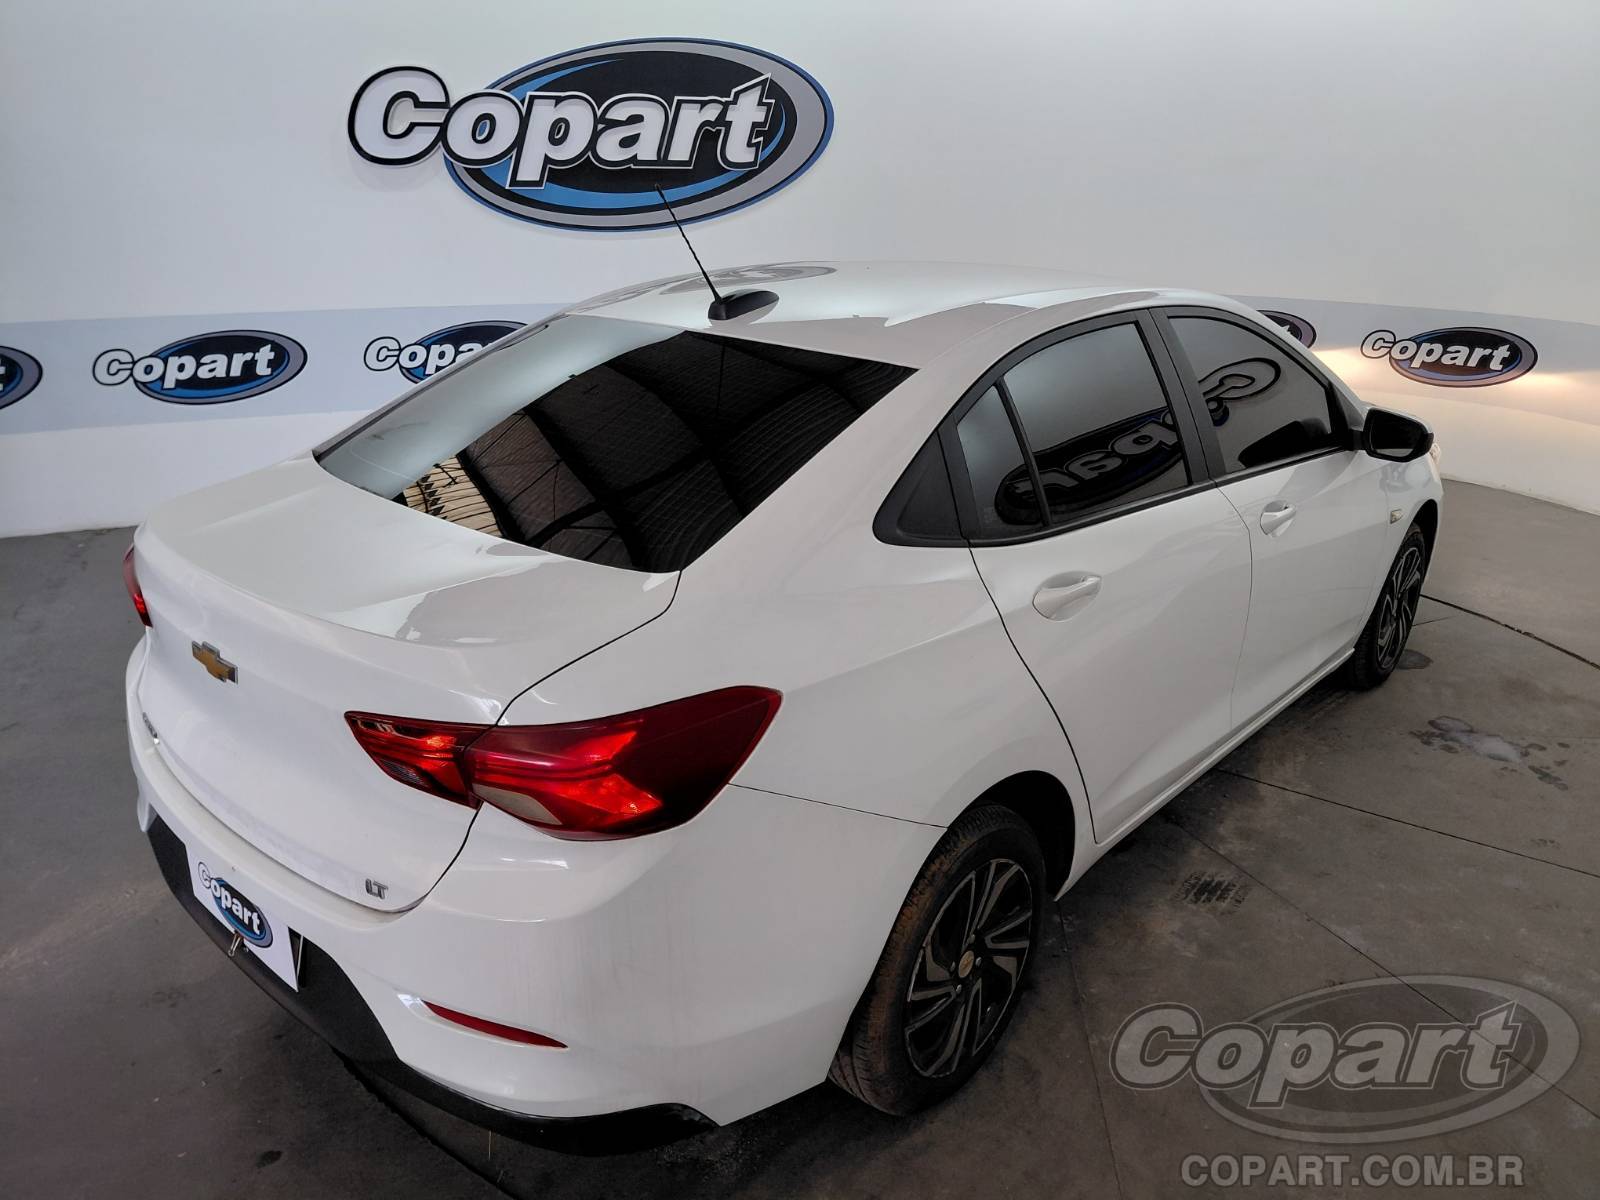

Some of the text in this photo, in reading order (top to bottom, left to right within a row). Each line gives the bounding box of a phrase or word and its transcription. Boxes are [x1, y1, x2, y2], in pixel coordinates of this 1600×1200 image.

[347, 65, 776, 189] Copart
[93, 344, 276, 390] Copart
[363, 336, 494, 375] Copa
[1360, 329, 1512, 371] Copart
[198, 861, 261, 935] Copart
[365, 878, 389, 900] LT
